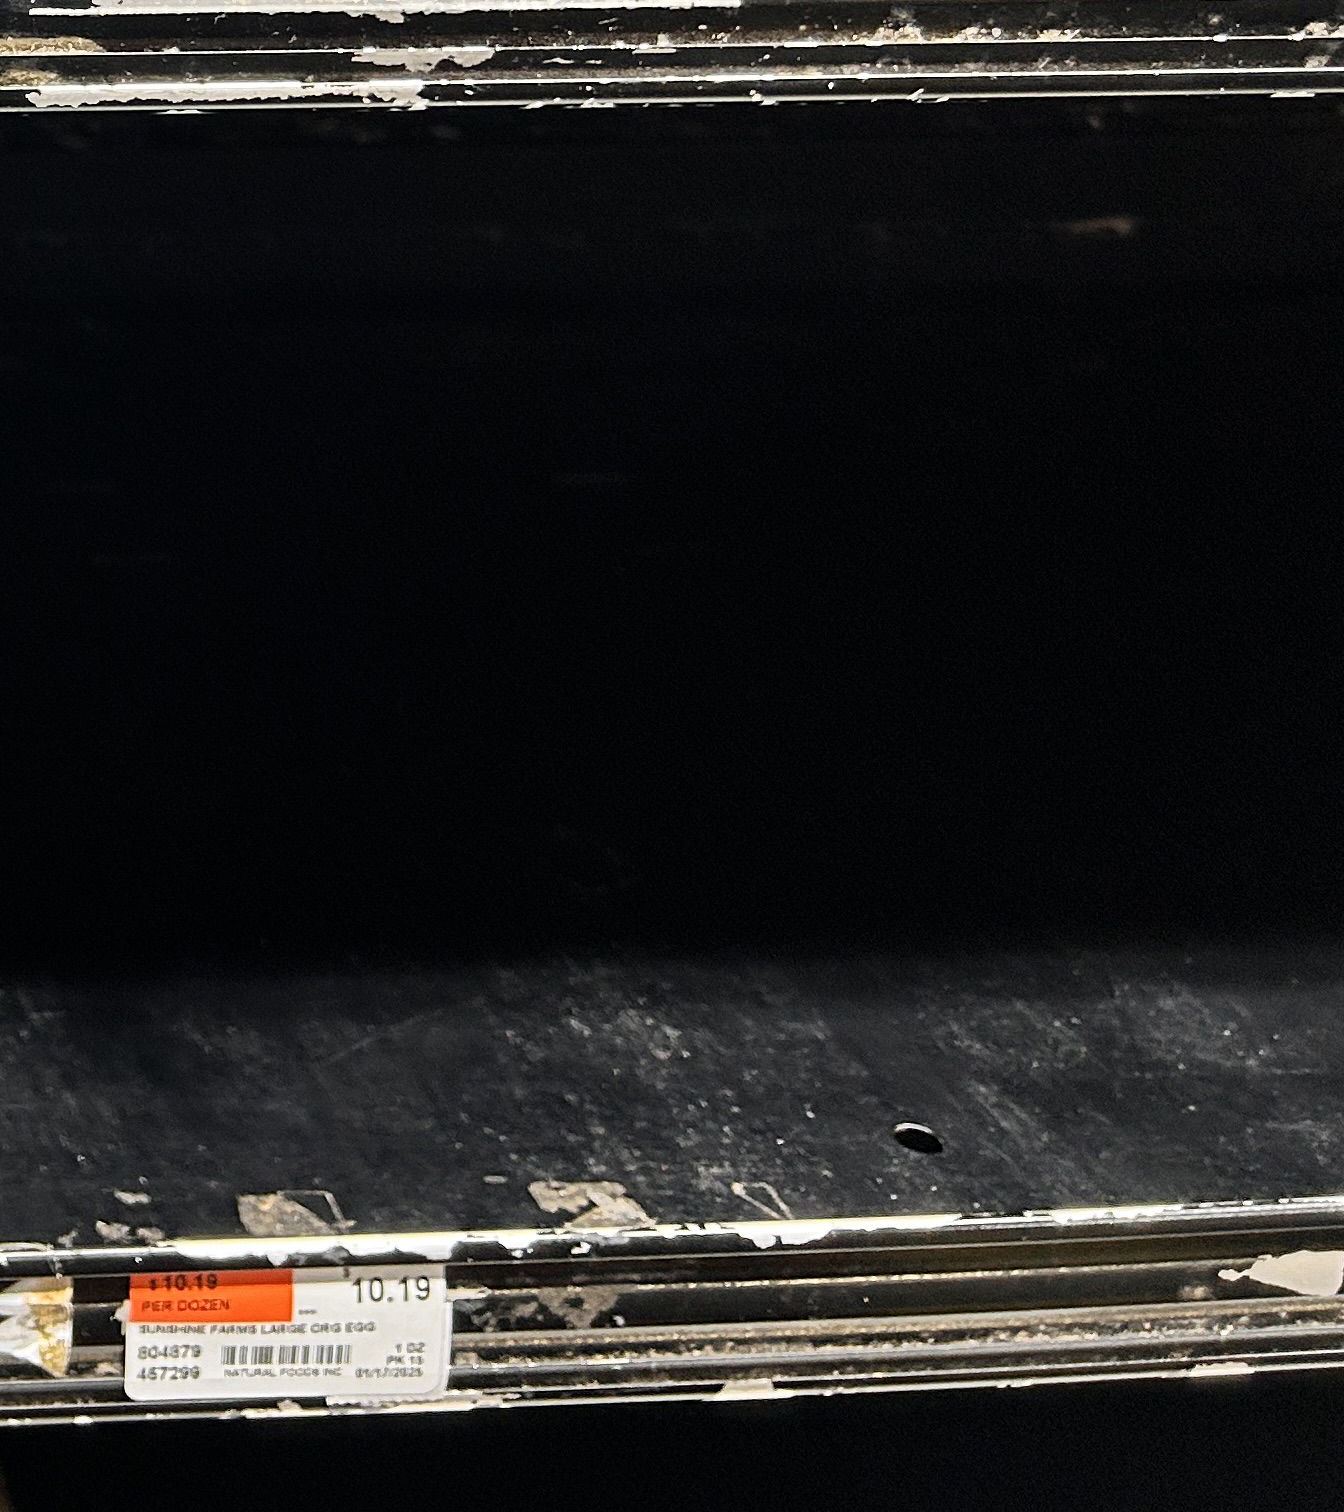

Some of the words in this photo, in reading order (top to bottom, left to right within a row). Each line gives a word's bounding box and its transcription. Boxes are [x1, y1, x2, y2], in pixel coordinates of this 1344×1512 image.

[164, 1274, 218, 1292] 10.19
[352, 1276, 430, 1303] 10.19
[142, 1300, 172, 1312] PER
[177, 1299, 230, 1311] DOZEN
[210, 1324, 257, 1335] FARMS
